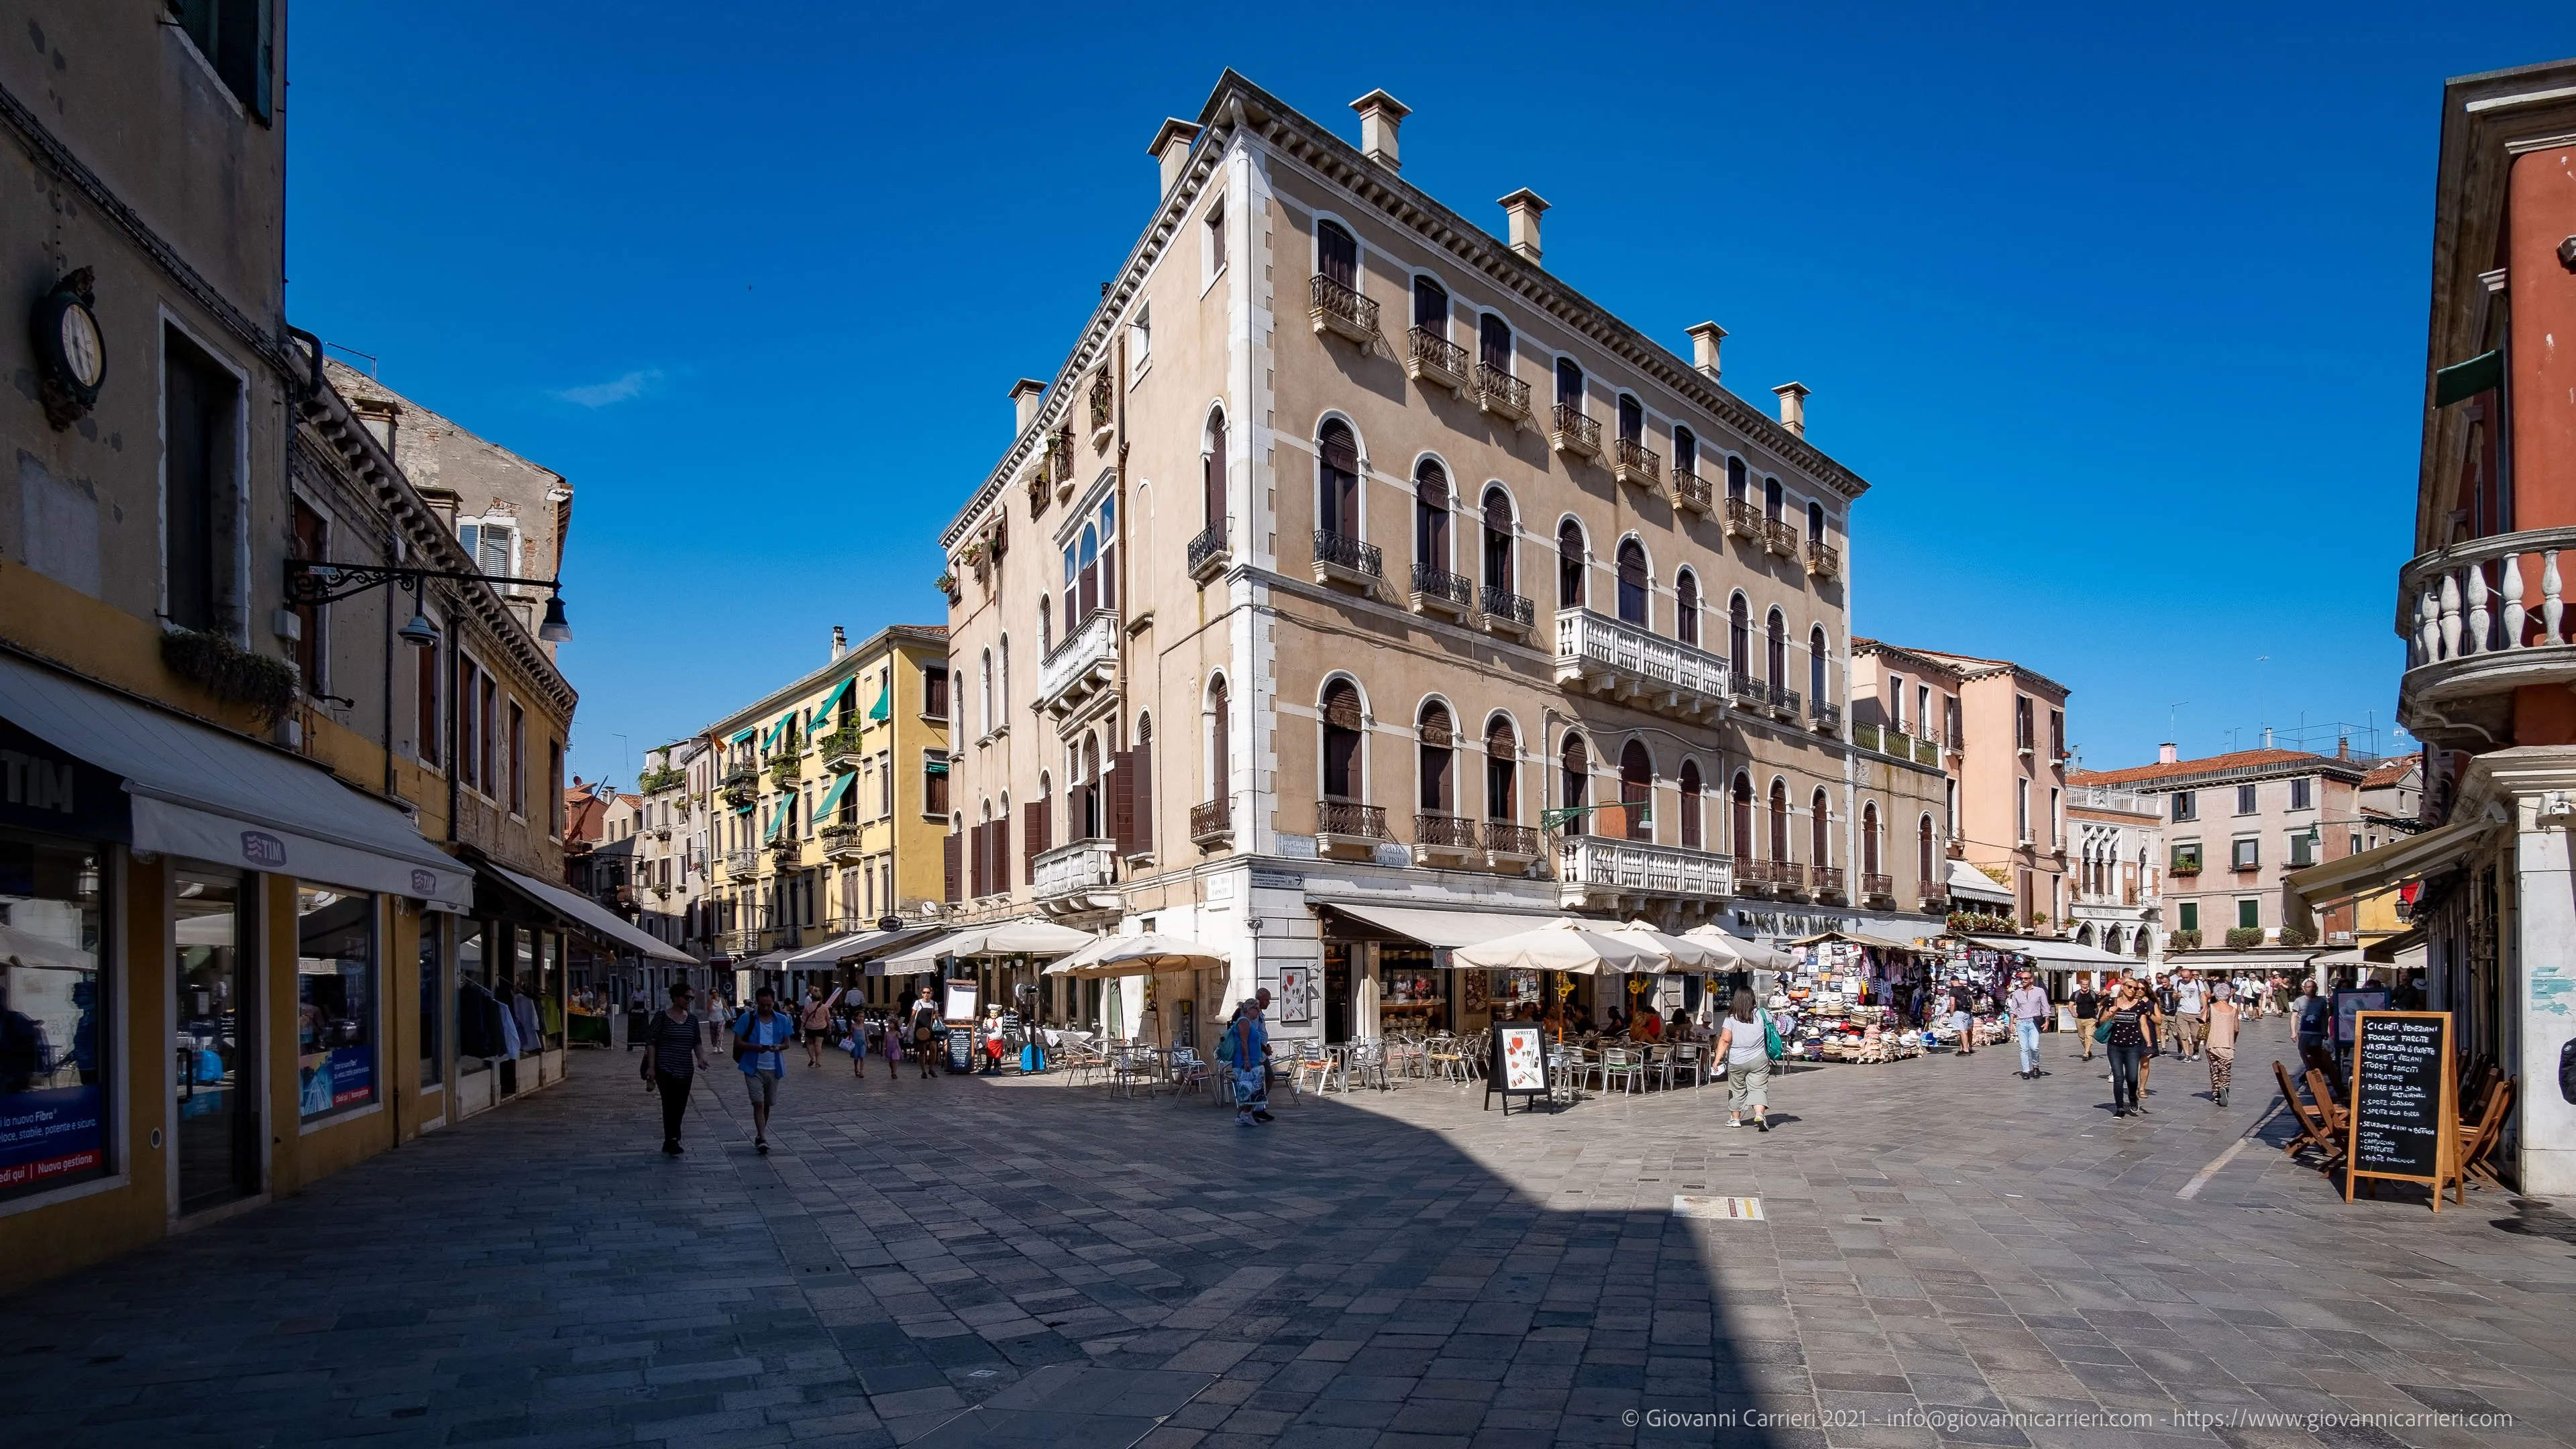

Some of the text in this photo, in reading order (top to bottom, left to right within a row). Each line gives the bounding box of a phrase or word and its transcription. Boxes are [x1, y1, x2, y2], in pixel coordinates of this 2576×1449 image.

[0, 749, 73, 814] TIM
[1283, 840, 1309, 848] OSPEDALE
[261, 839, 282, 862] TIM
[1737, 911, 1844, 932] BANCO SAN MARCO
[2401, 1035, 2430, 1043] FARCITE
[2366, 1052, 2422, 1063] CICHETI VEGANI
[2364, 1061, 2388, 1070] TOAST
[2367, 1083, 2387, 1091] BIRRE
[0, 1131, 18, 1143] eloce,
[19, 1126, 44, 1140] stabile,
[45, 1122, 70, 1138] potente
[2363, 1145, 2394, 1153] CAFFELATTE
[0, 1154, 93, 1183] edi qui Nuova gestione
